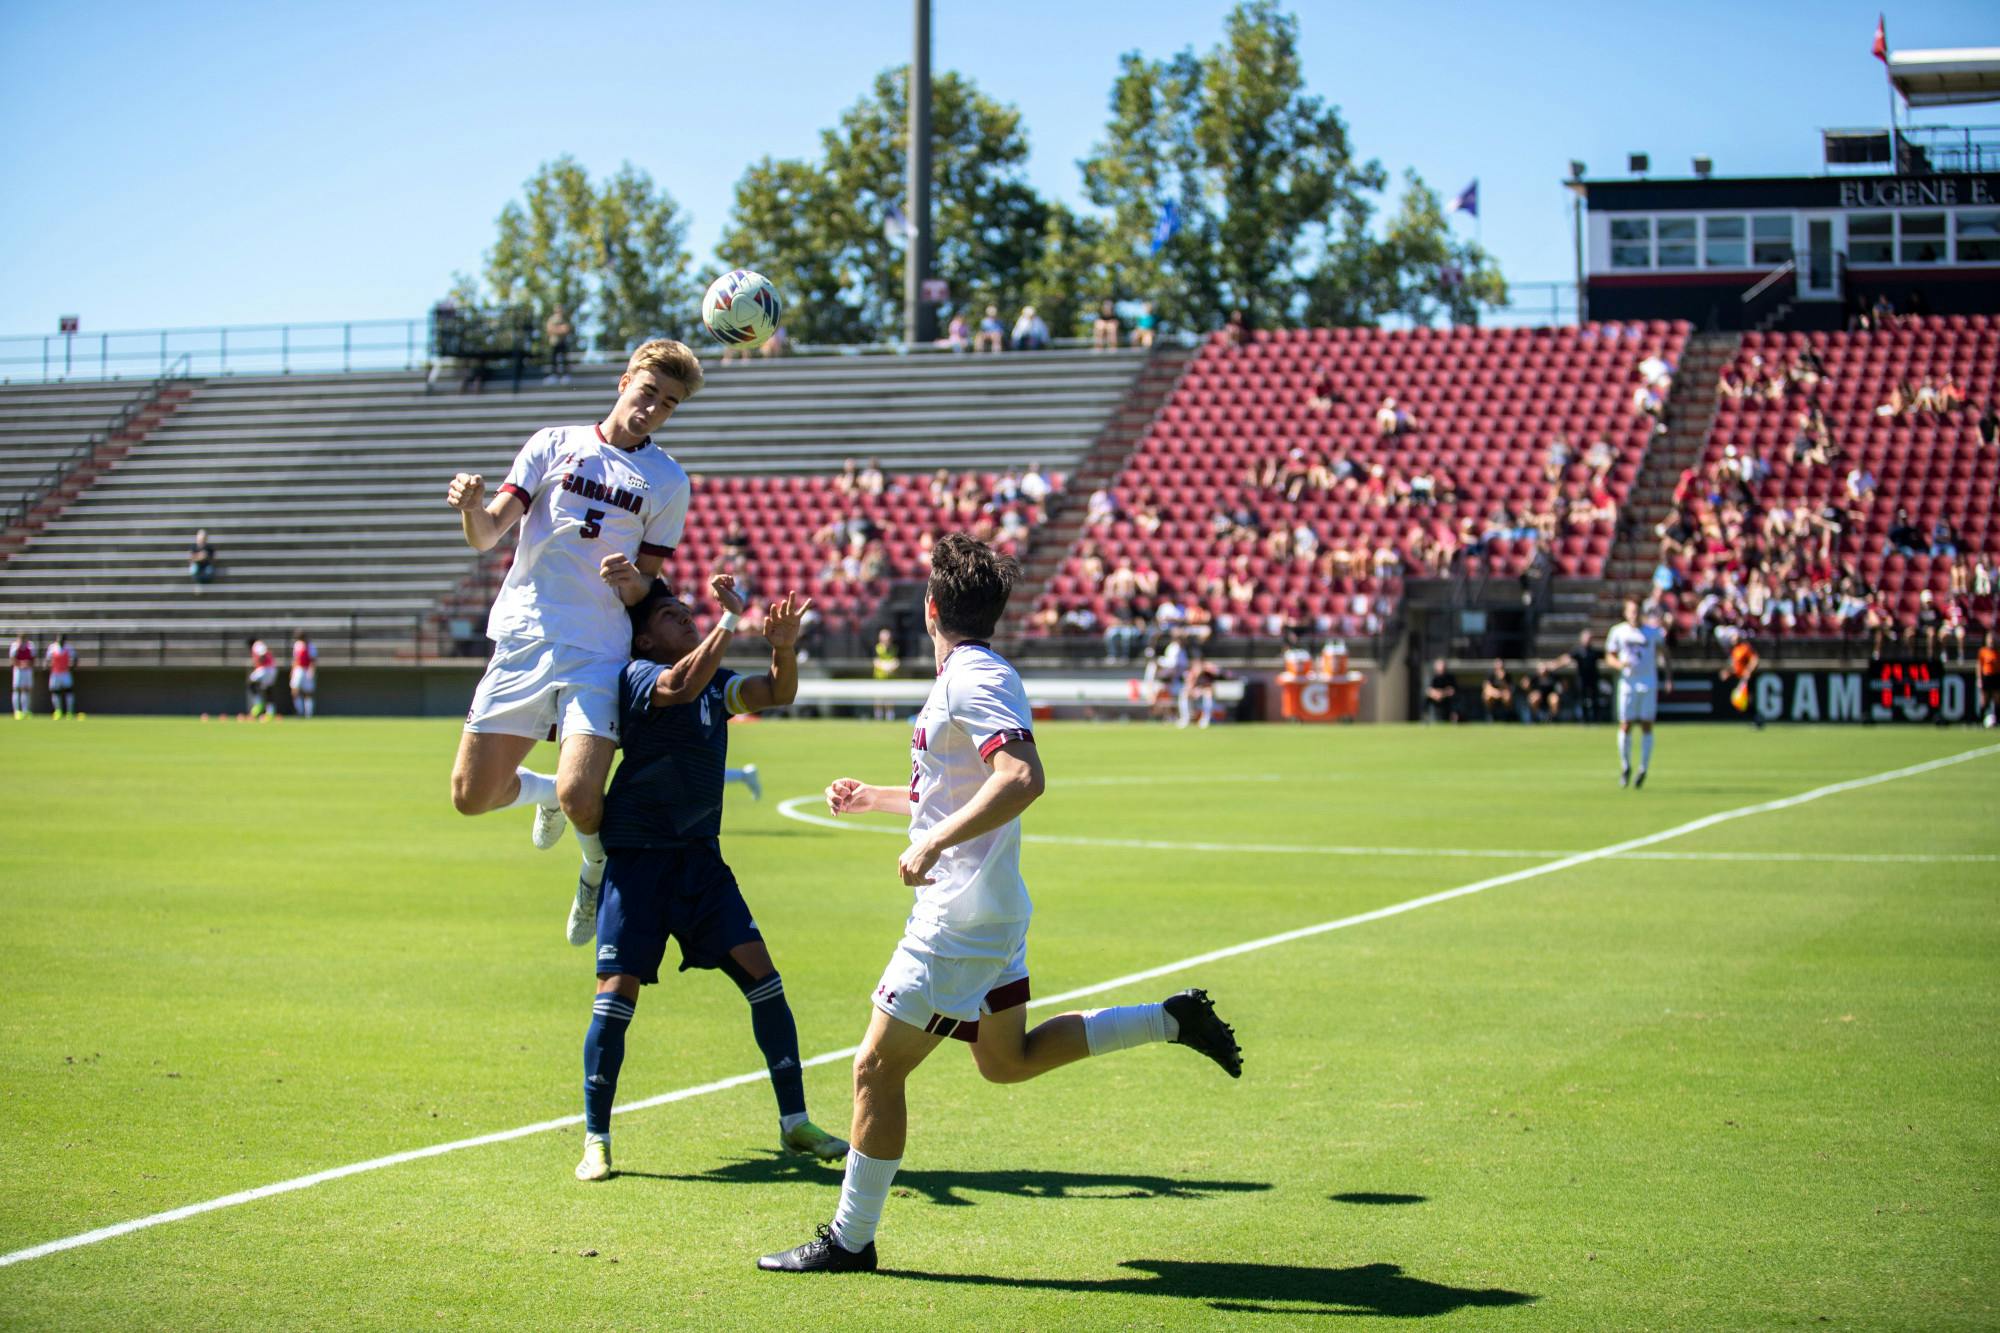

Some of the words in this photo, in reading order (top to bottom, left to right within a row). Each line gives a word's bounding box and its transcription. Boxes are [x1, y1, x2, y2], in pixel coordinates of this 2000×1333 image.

[1840, 179, 1957, 206] EUGENE
[561, 473, 643, 515] CAROLINA
[580, 508, 605, 538] 5
[1302, 683, 1329, 715] G
